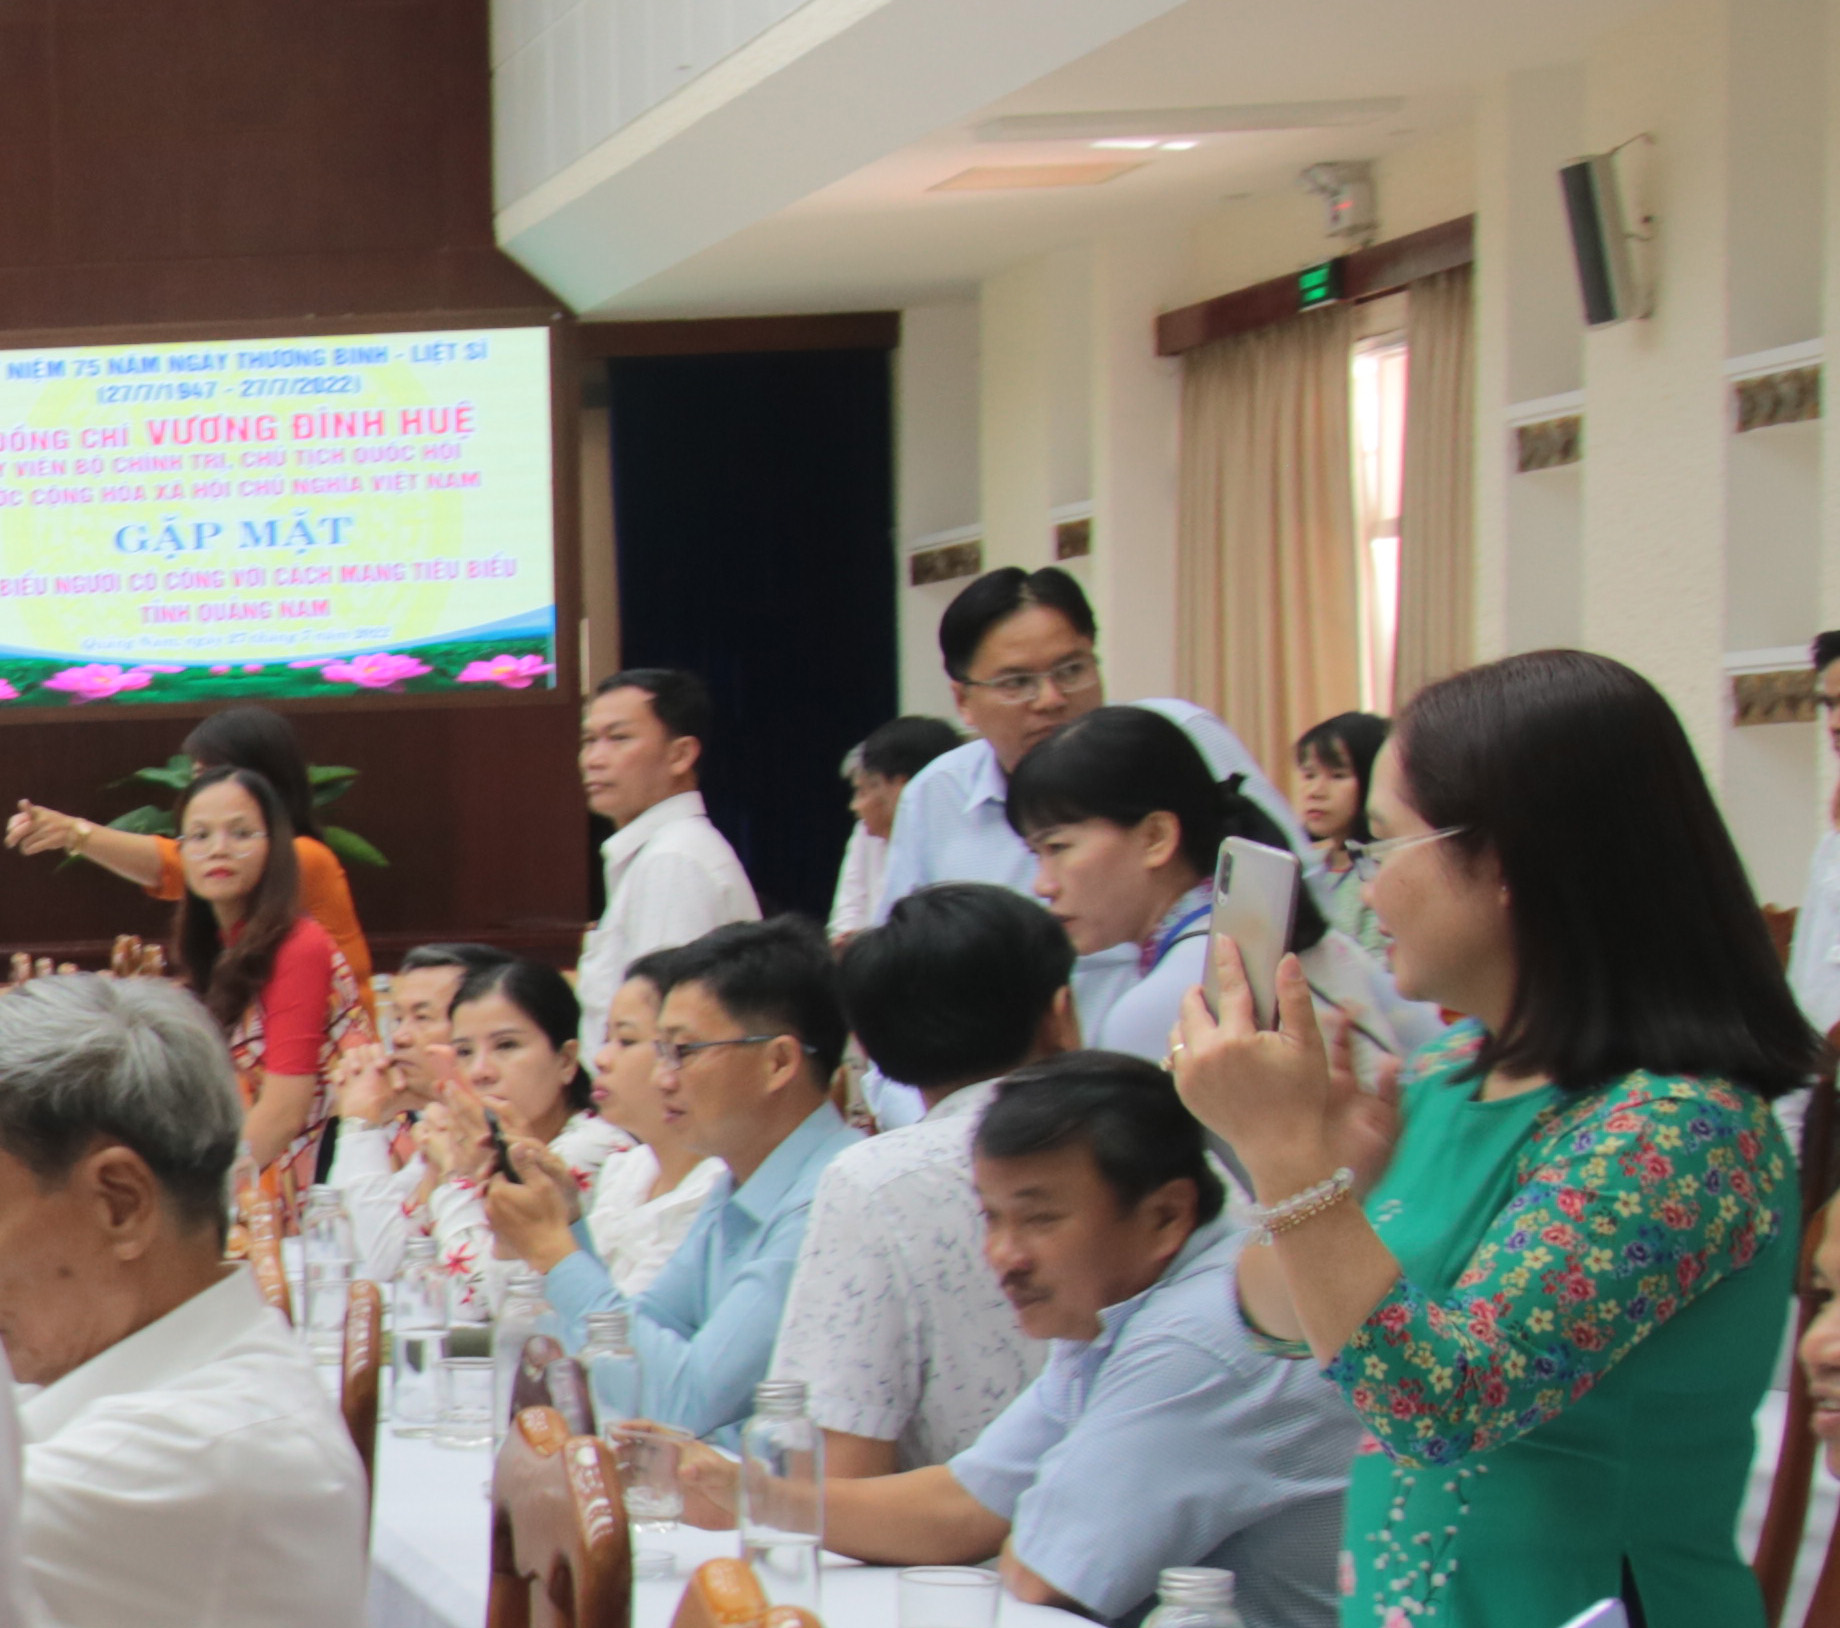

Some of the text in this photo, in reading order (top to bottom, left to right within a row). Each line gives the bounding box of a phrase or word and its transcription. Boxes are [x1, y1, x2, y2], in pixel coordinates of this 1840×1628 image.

[80, 422, 129, 449] CHÍ
[146, 413, 278, 446] VƯƠNG
[292, 406, 386, 440] ĐÌNH
[400, 400, 475, 441] HUỆ
[426, 470, 480, 490] NAM
[113, 508, 353, 560] GẶP MẶT
[279, 599, 330, 618] NAM
